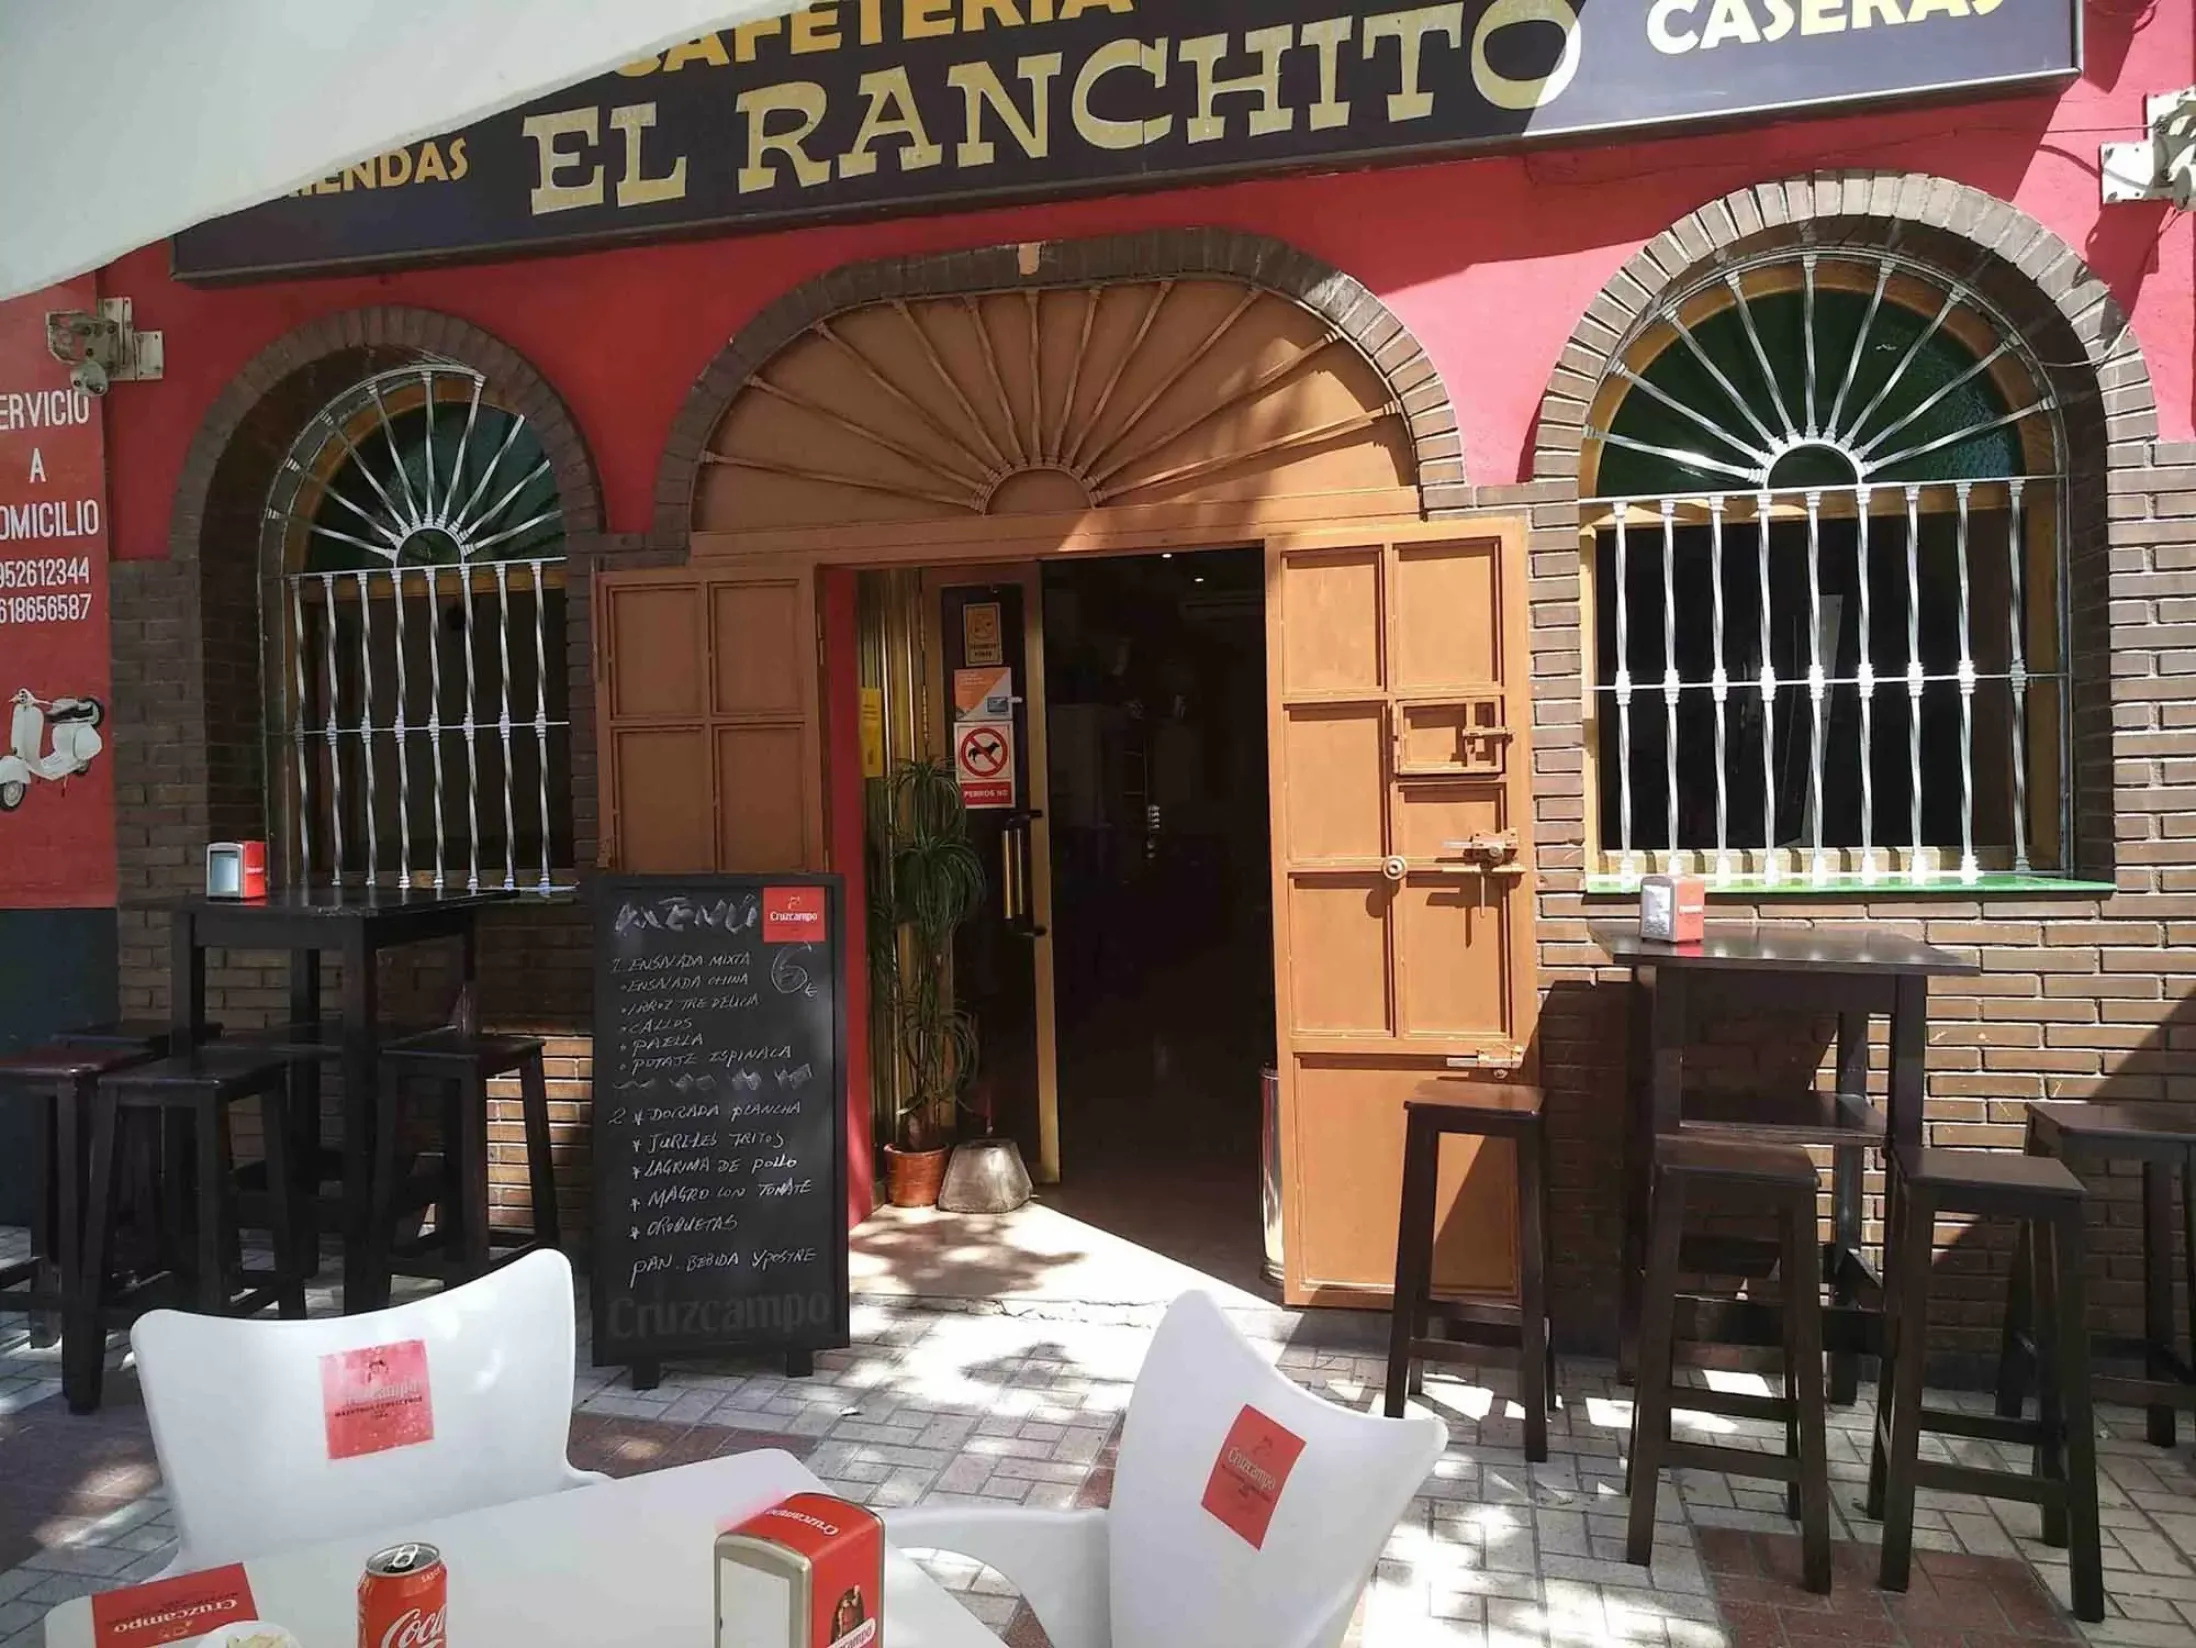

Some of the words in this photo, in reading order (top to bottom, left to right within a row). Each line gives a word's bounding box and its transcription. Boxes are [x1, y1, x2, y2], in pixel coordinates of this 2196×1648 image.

[522, 101, 687, 215] EL
[735, 0, 1581, 194] RANCHITO
[29, 447, 47, 483] A
[769, 911, 818, 923] Cruzcampo
[709, 951, 751, 967] MIXTA
[707, 972, 749, 985] CHINA
[629, 1018, 692, 1034] CALLOS
[632, 1033, 704, 1057] PAELLA
[608, 1107, 626, 1125] 2
[648, 1104, 719, 1122] DORADA
[644, 1156, 710, 1178] LAGRIMA
[718, 1158, 741, 1173] DE
[648, 1186, 710, 1208] MAGRO
[758, 1178, 812, 1197] TOMATE
[687, 1252, 739, 1272] BEBIDA
[607, 1290, 831, 1340] Cruzcampo
[1227, 1446, 1276, 1491] Cruzcampo
[113, 1598, 238, 1633] Cruzcampo
